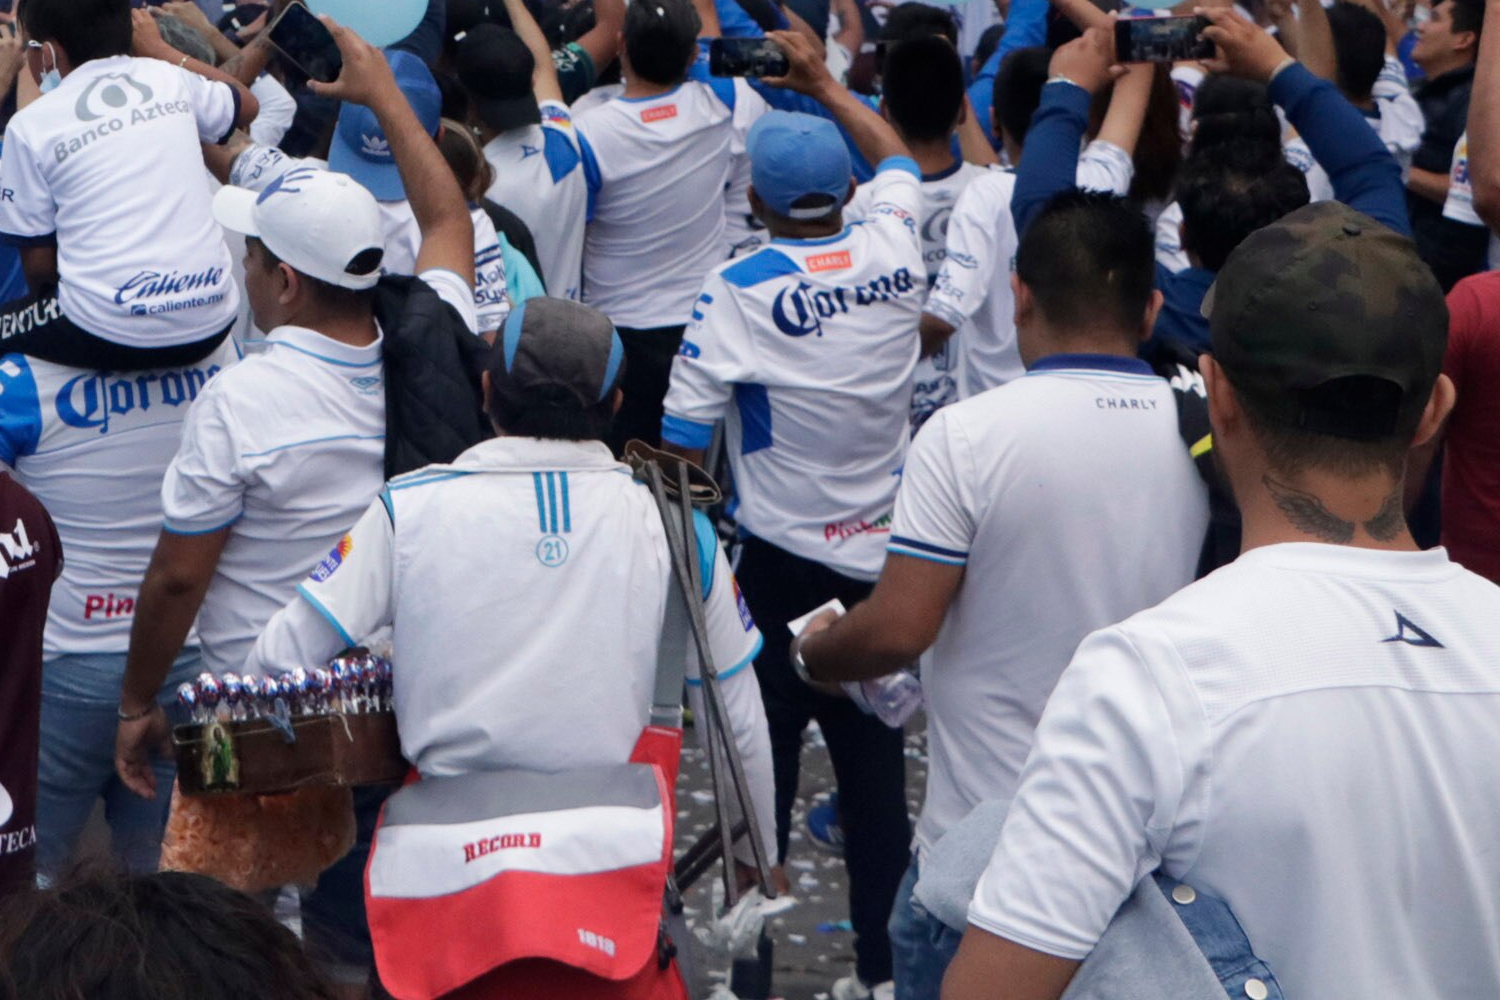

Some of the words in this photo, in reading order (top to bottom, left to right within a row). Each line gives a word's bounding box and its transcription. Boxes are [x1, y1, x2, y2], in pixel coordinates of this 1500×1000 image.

[54, 118, 124, 163] Banco
[130, 97, 190, 127] Azteca
[808, 253, 851, 272] CHARLY
[115, 267, 224, 304] Caliente
[772, 267, 913, 338] Corona
[1095, 397, 1157, 410] CHARLY
[543, 540, 562, 561] 21
[463, 832, 542, 864] RECORD
